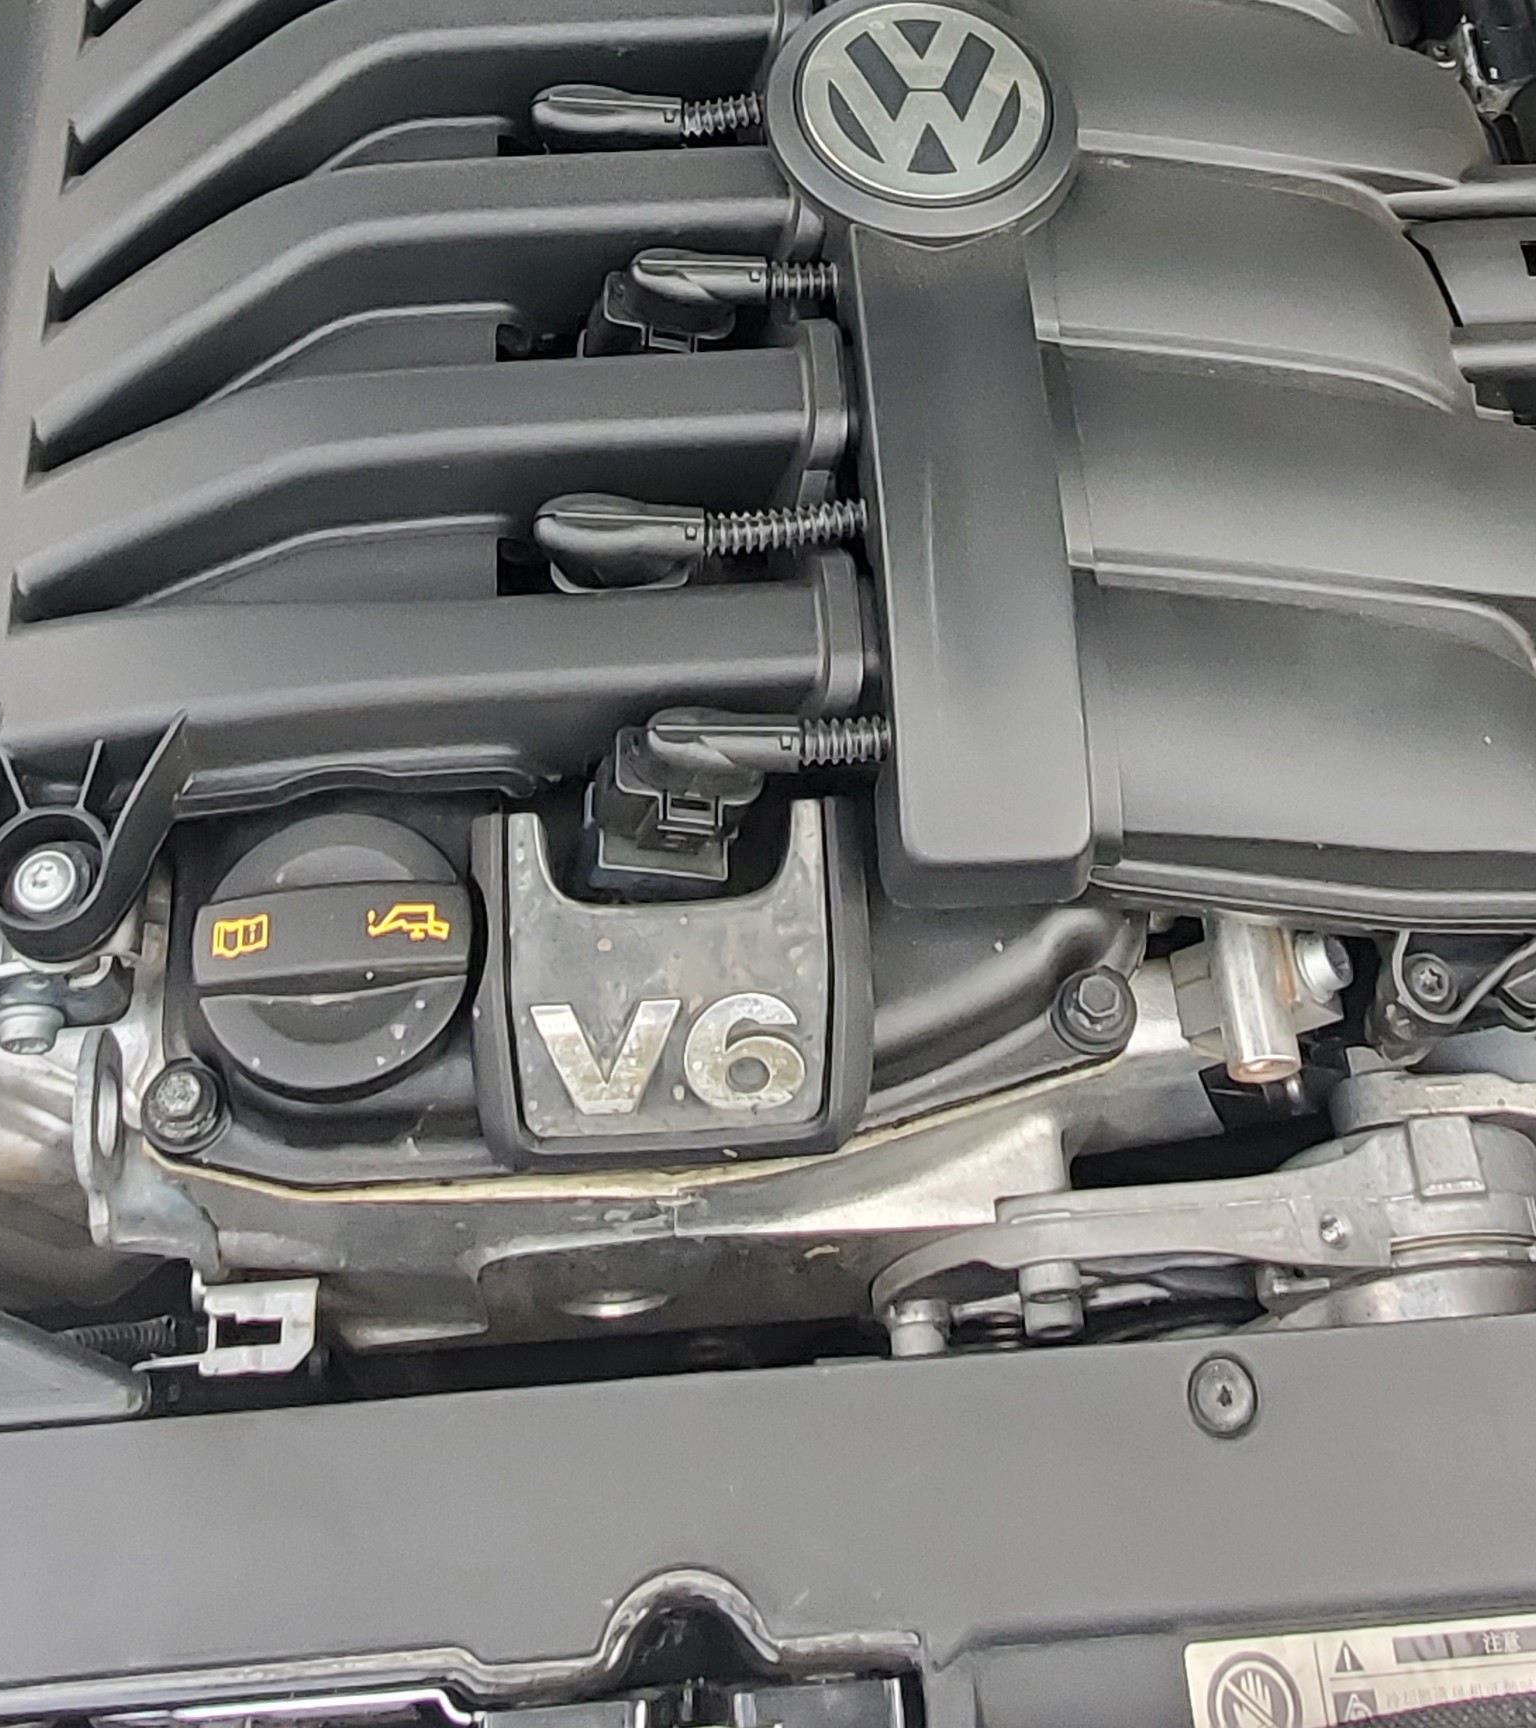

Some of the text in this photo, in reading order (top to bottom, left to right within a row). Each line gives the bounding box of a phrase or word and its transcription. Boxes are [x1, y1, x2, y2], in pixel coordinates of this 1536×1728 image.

[802, 2, 1047, 199] VW
[530, 993, 806, 1116] V6
[1482, 1631, 1522, 1654] 注意
